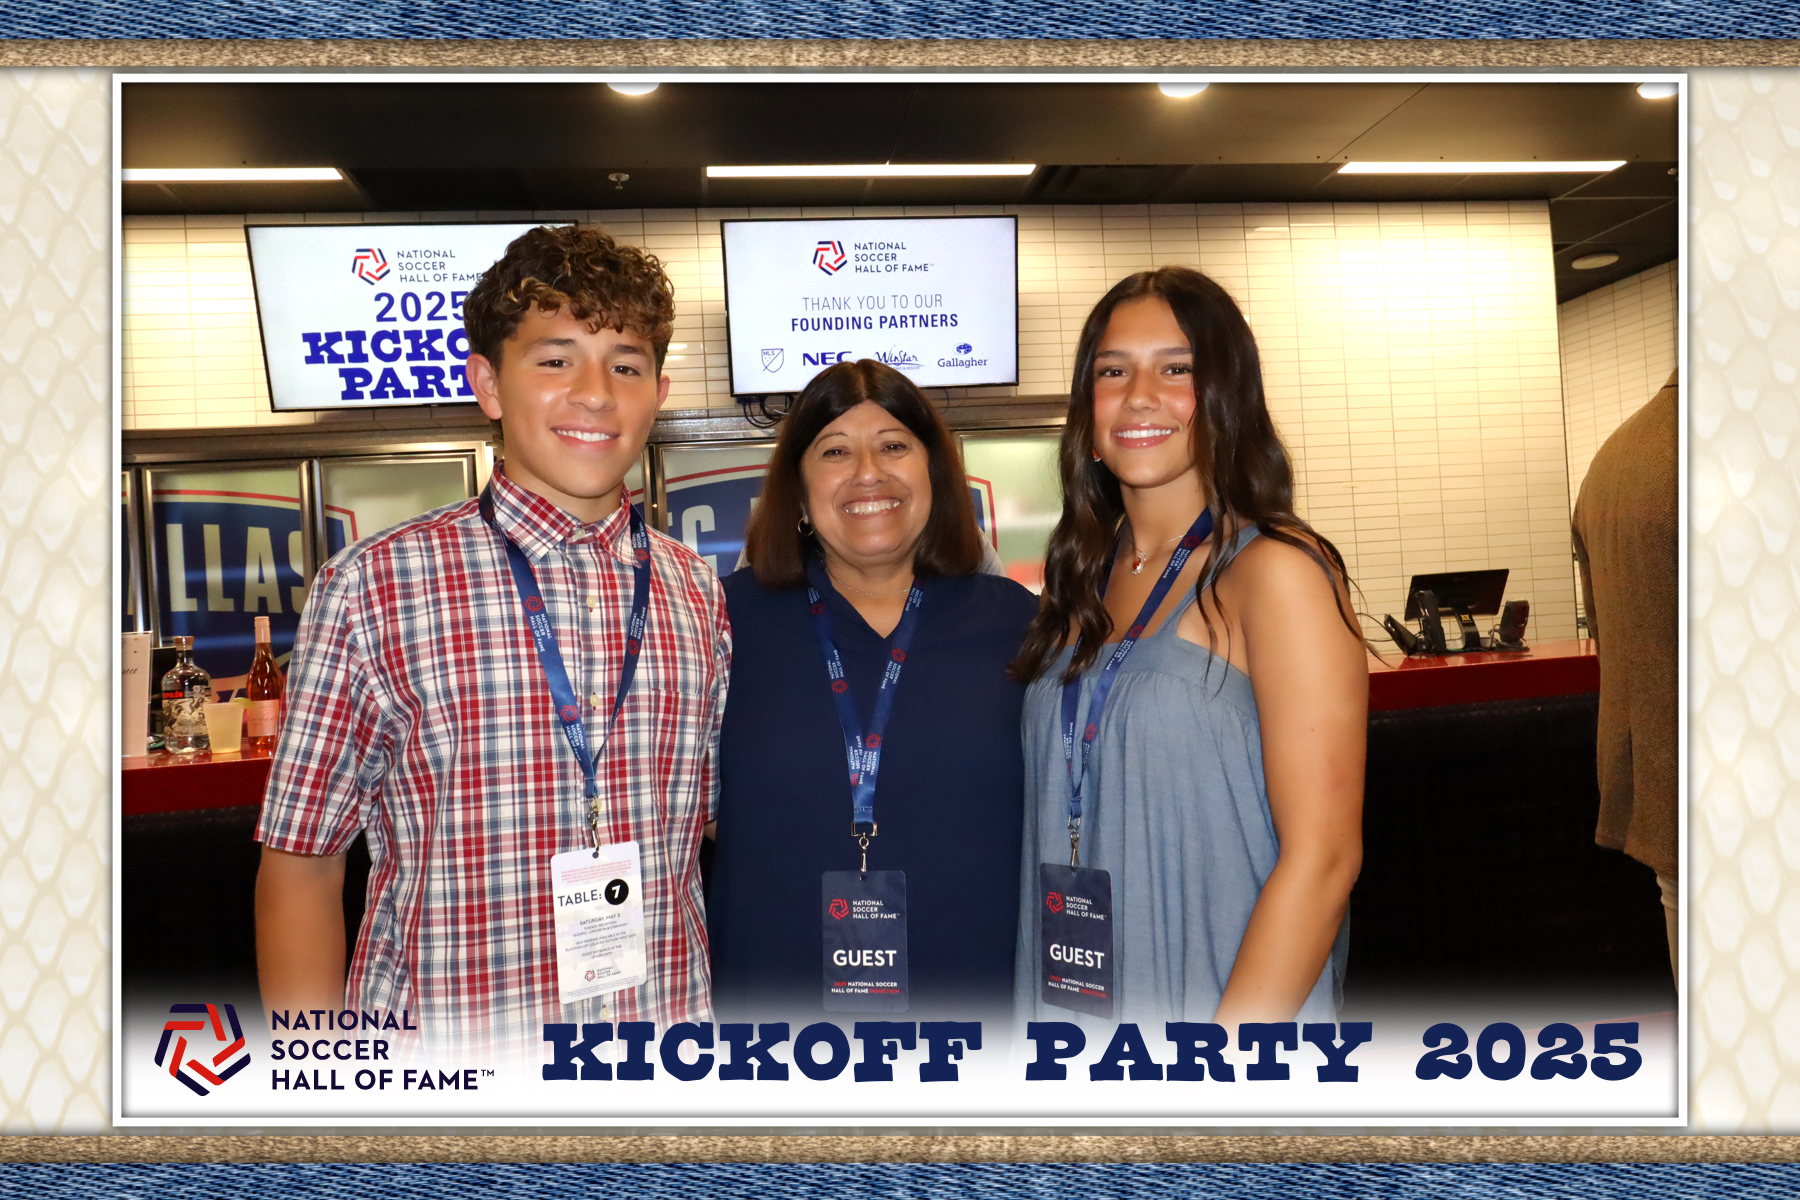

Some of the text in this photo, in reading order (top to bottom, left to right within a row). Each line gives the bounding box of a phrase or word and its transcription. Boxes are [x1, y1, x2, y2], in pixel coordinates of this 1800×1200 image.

[397, 249, 456, 259] NATIONAL
[854, 242, 906, 251] NATIONAL
[855, 253, 897, 262] SOCCER
[398, 261, 446, 271] SOCCER
[855, 264, 881, 273] HALL
[885, 263, 899, 273] OF
[400, 273, 430, 283] HALL
[433, 273, 449, 283] OF
[374, 291, 469, 322] 2025
[802, 294, 943, 311] THANK YOU TO OUR
[791, 313, 959, 332] FOUNDING PARTNERS
[937, 357, 988, 369] Gallagher
[534, 614, 546, 636] SOCCER
[540, 613, 552, 640] NATIONAL
[529, 615, 537, 630] HALL
[537, 638, 546, 652] FAME
[570, 724, 580, 747] SOCCER
[575, 723, 585, 750] NATIONAL
[870, 751, 878, 776] NATIONAL
[557, 889, 602, 907] TABLE:
[1065, 895, 1093, 905] NATIONAL
[1065, 902, 1088, 911] SOCCER
[1066, 909, 1080, 918] HALL
[833, 949, 897, 967] GUEST
[1049, 944, 1105, 969] GUEST
[1047, 980, 1060, 989] HALL
[1067, 985, 1080, 993] FAME
[1061, 977, 1085, 987] NATIONAL
[1085, 982, 1105, 991] SOCCER
